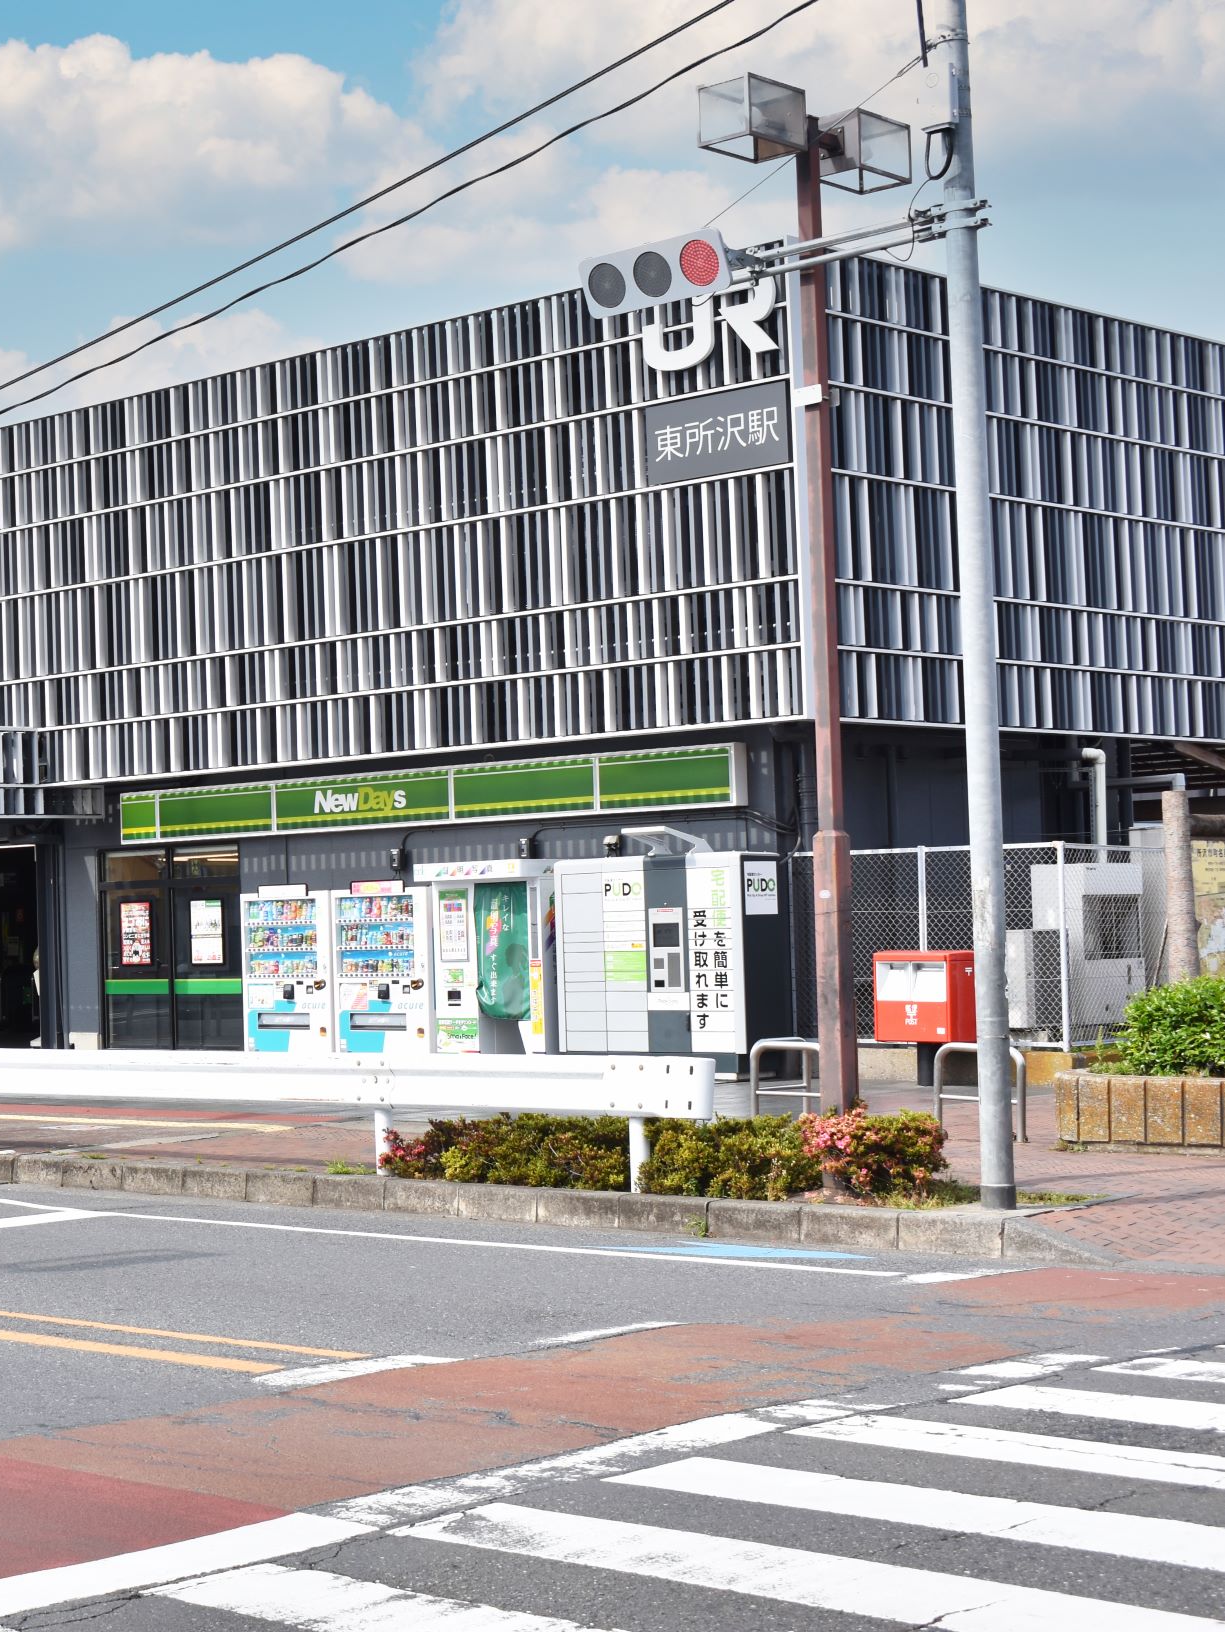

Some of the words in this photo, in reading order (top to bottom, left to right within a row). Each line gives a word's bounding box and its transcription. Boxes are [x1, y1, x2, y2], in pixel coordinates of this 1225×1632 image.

[654, 406, 780, 463] 東所沢駅
[314, 786, 407, 814] NewDays
[604, 882, 642, 896] PUDO
[746, 878, 776, 892] PUDO
[711, 869, 729, 1009] 宅配便を簡単に
[692, 910, 709, 1029] 受け取れます
[397, 1001, 424, 1010] acure
